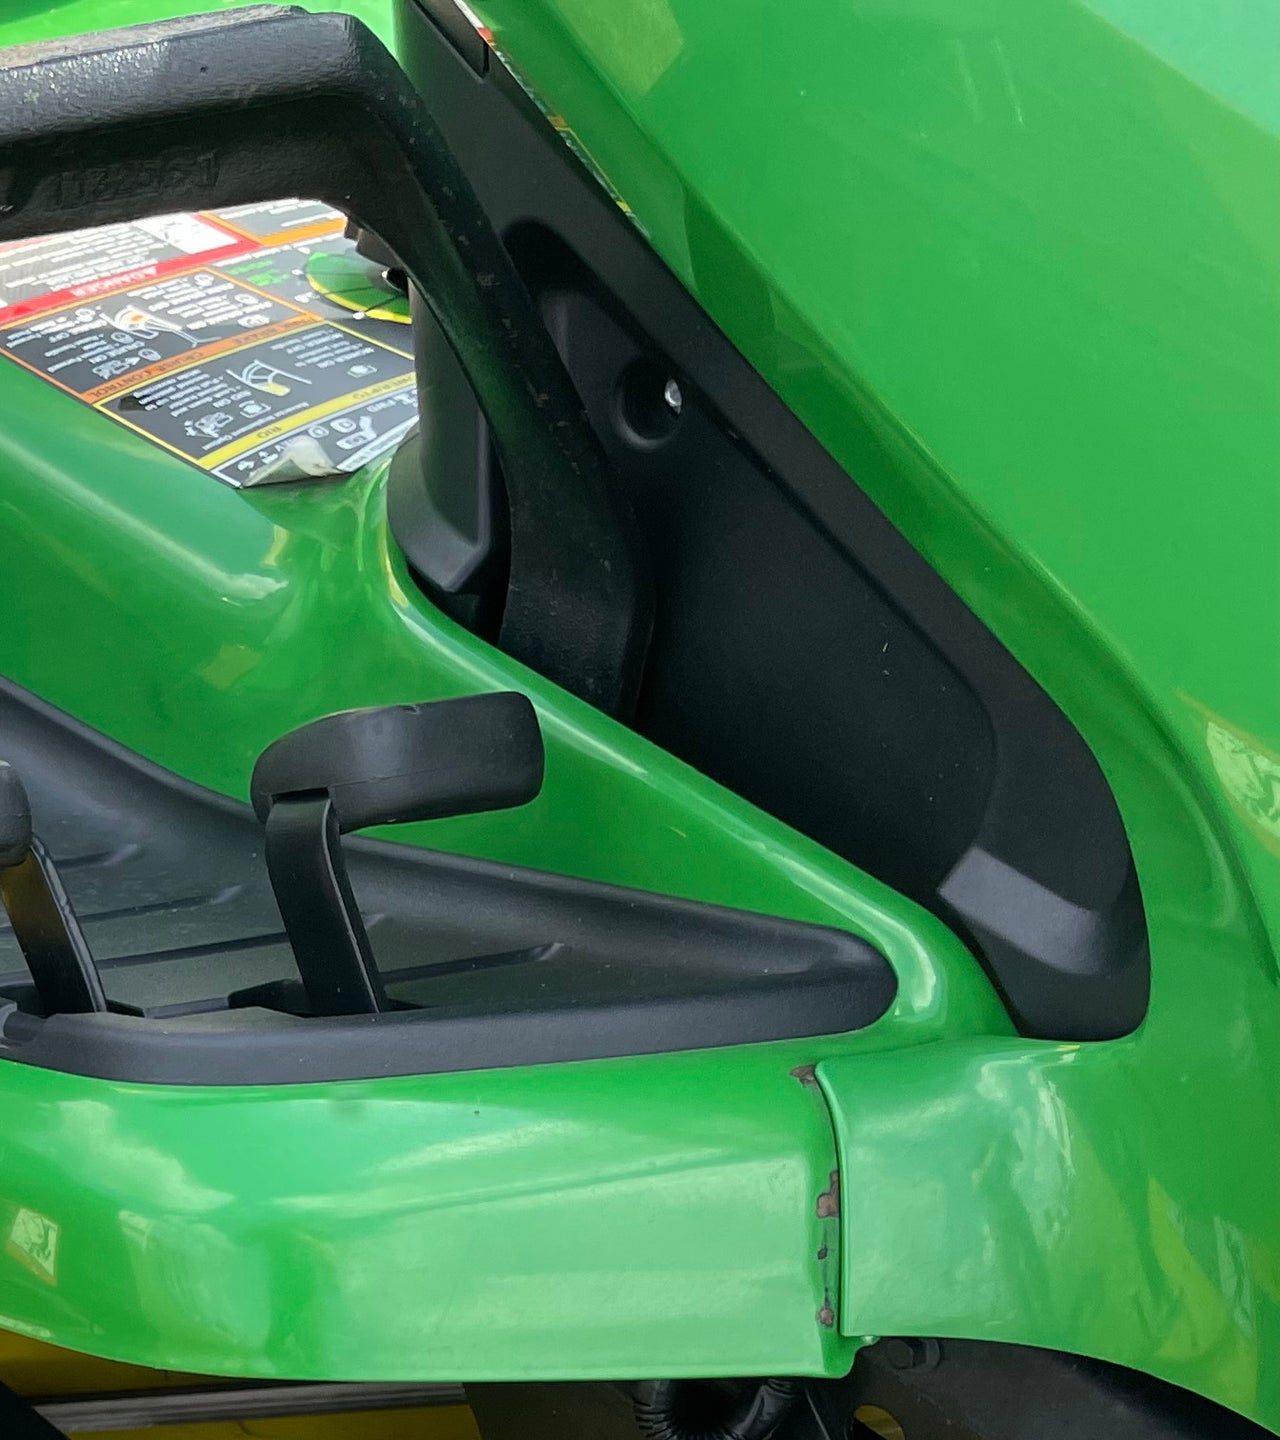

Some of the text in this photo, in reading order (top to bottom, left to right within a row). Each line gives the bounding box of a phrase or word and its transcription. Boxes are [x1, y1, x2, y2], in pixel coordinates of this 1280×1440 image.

[71, 272, 141, 297] DANGER
[93, 370, 148, 398] CONTROL
[257, 426, 283, 439] RIO
